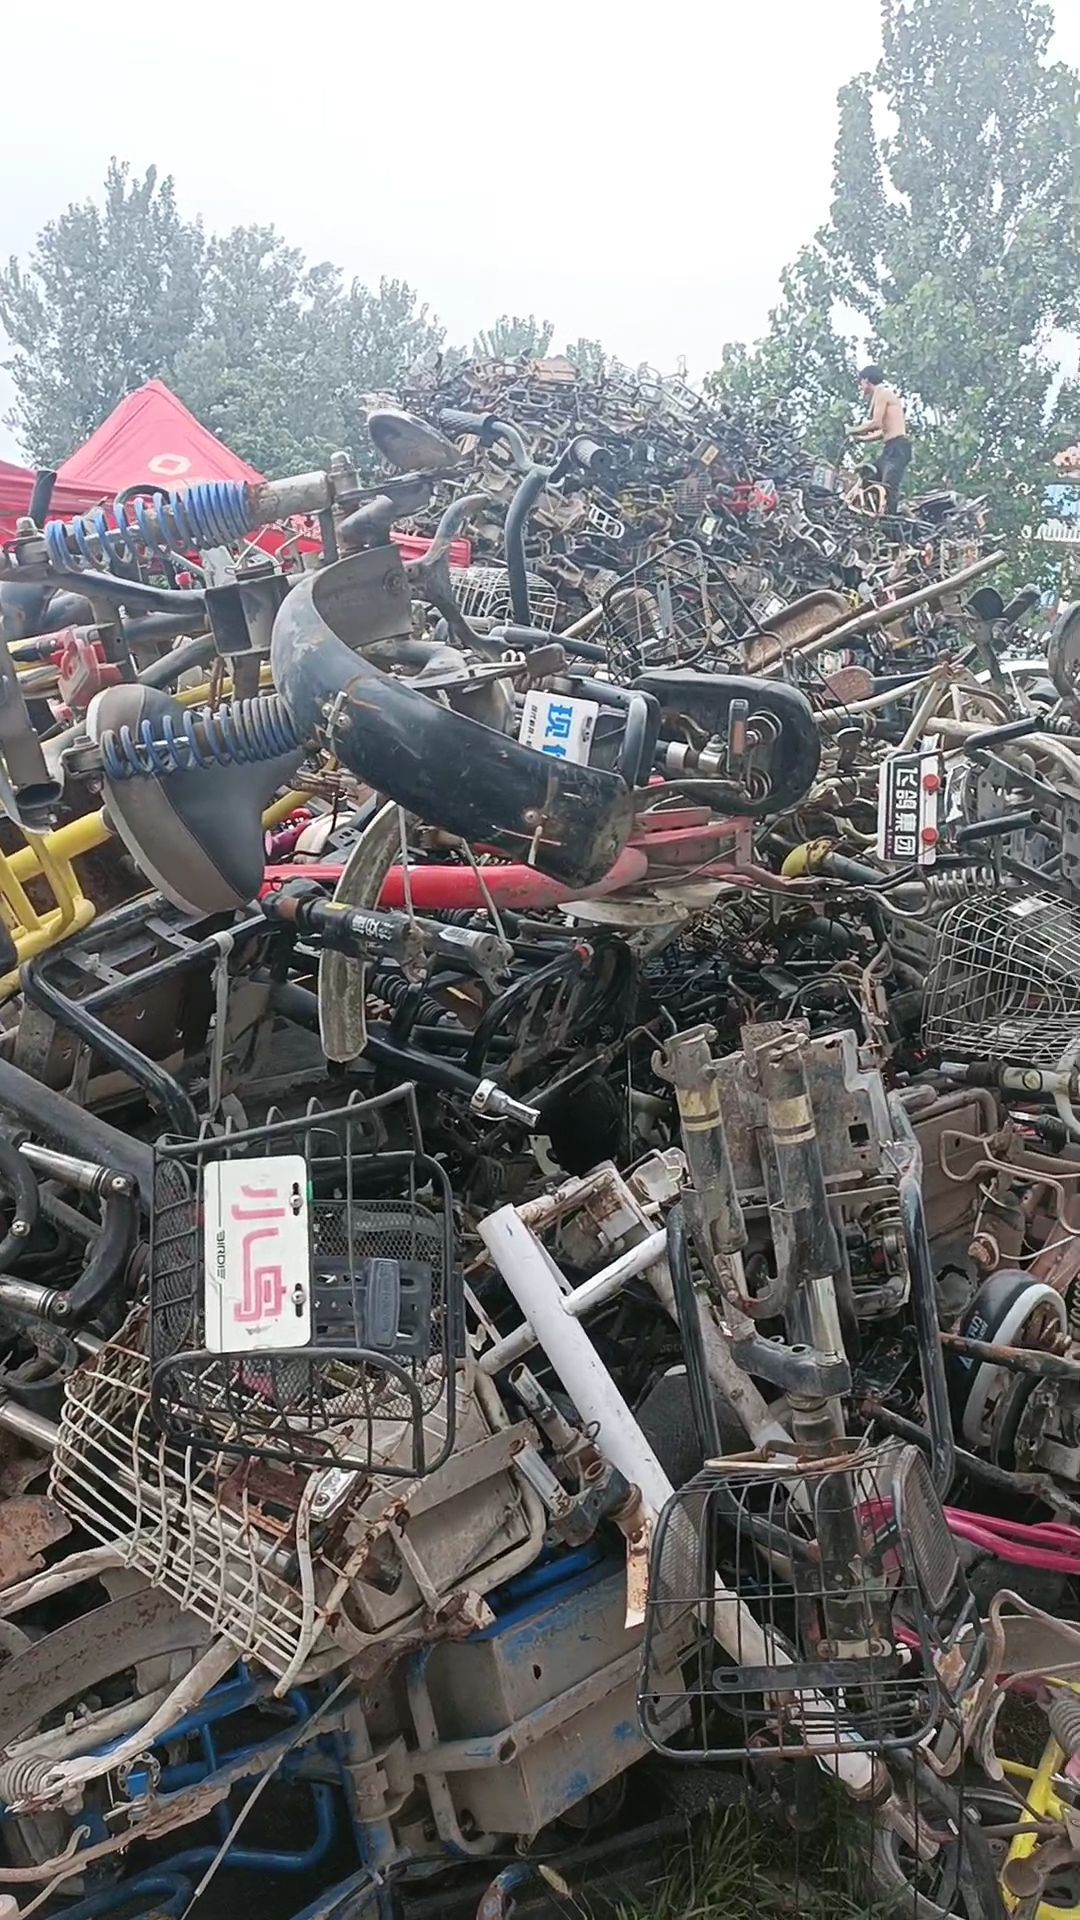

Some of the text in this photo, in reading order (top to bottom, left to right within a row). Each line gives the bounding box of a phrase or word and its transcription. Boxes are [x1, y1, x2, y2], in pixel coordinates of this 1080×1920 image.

[894, 766, 918, 856] 飞鸽集团
[216, 1229, 226, 1280] BIRDIE
[230, 1184, 287, 1323] 小鸟
